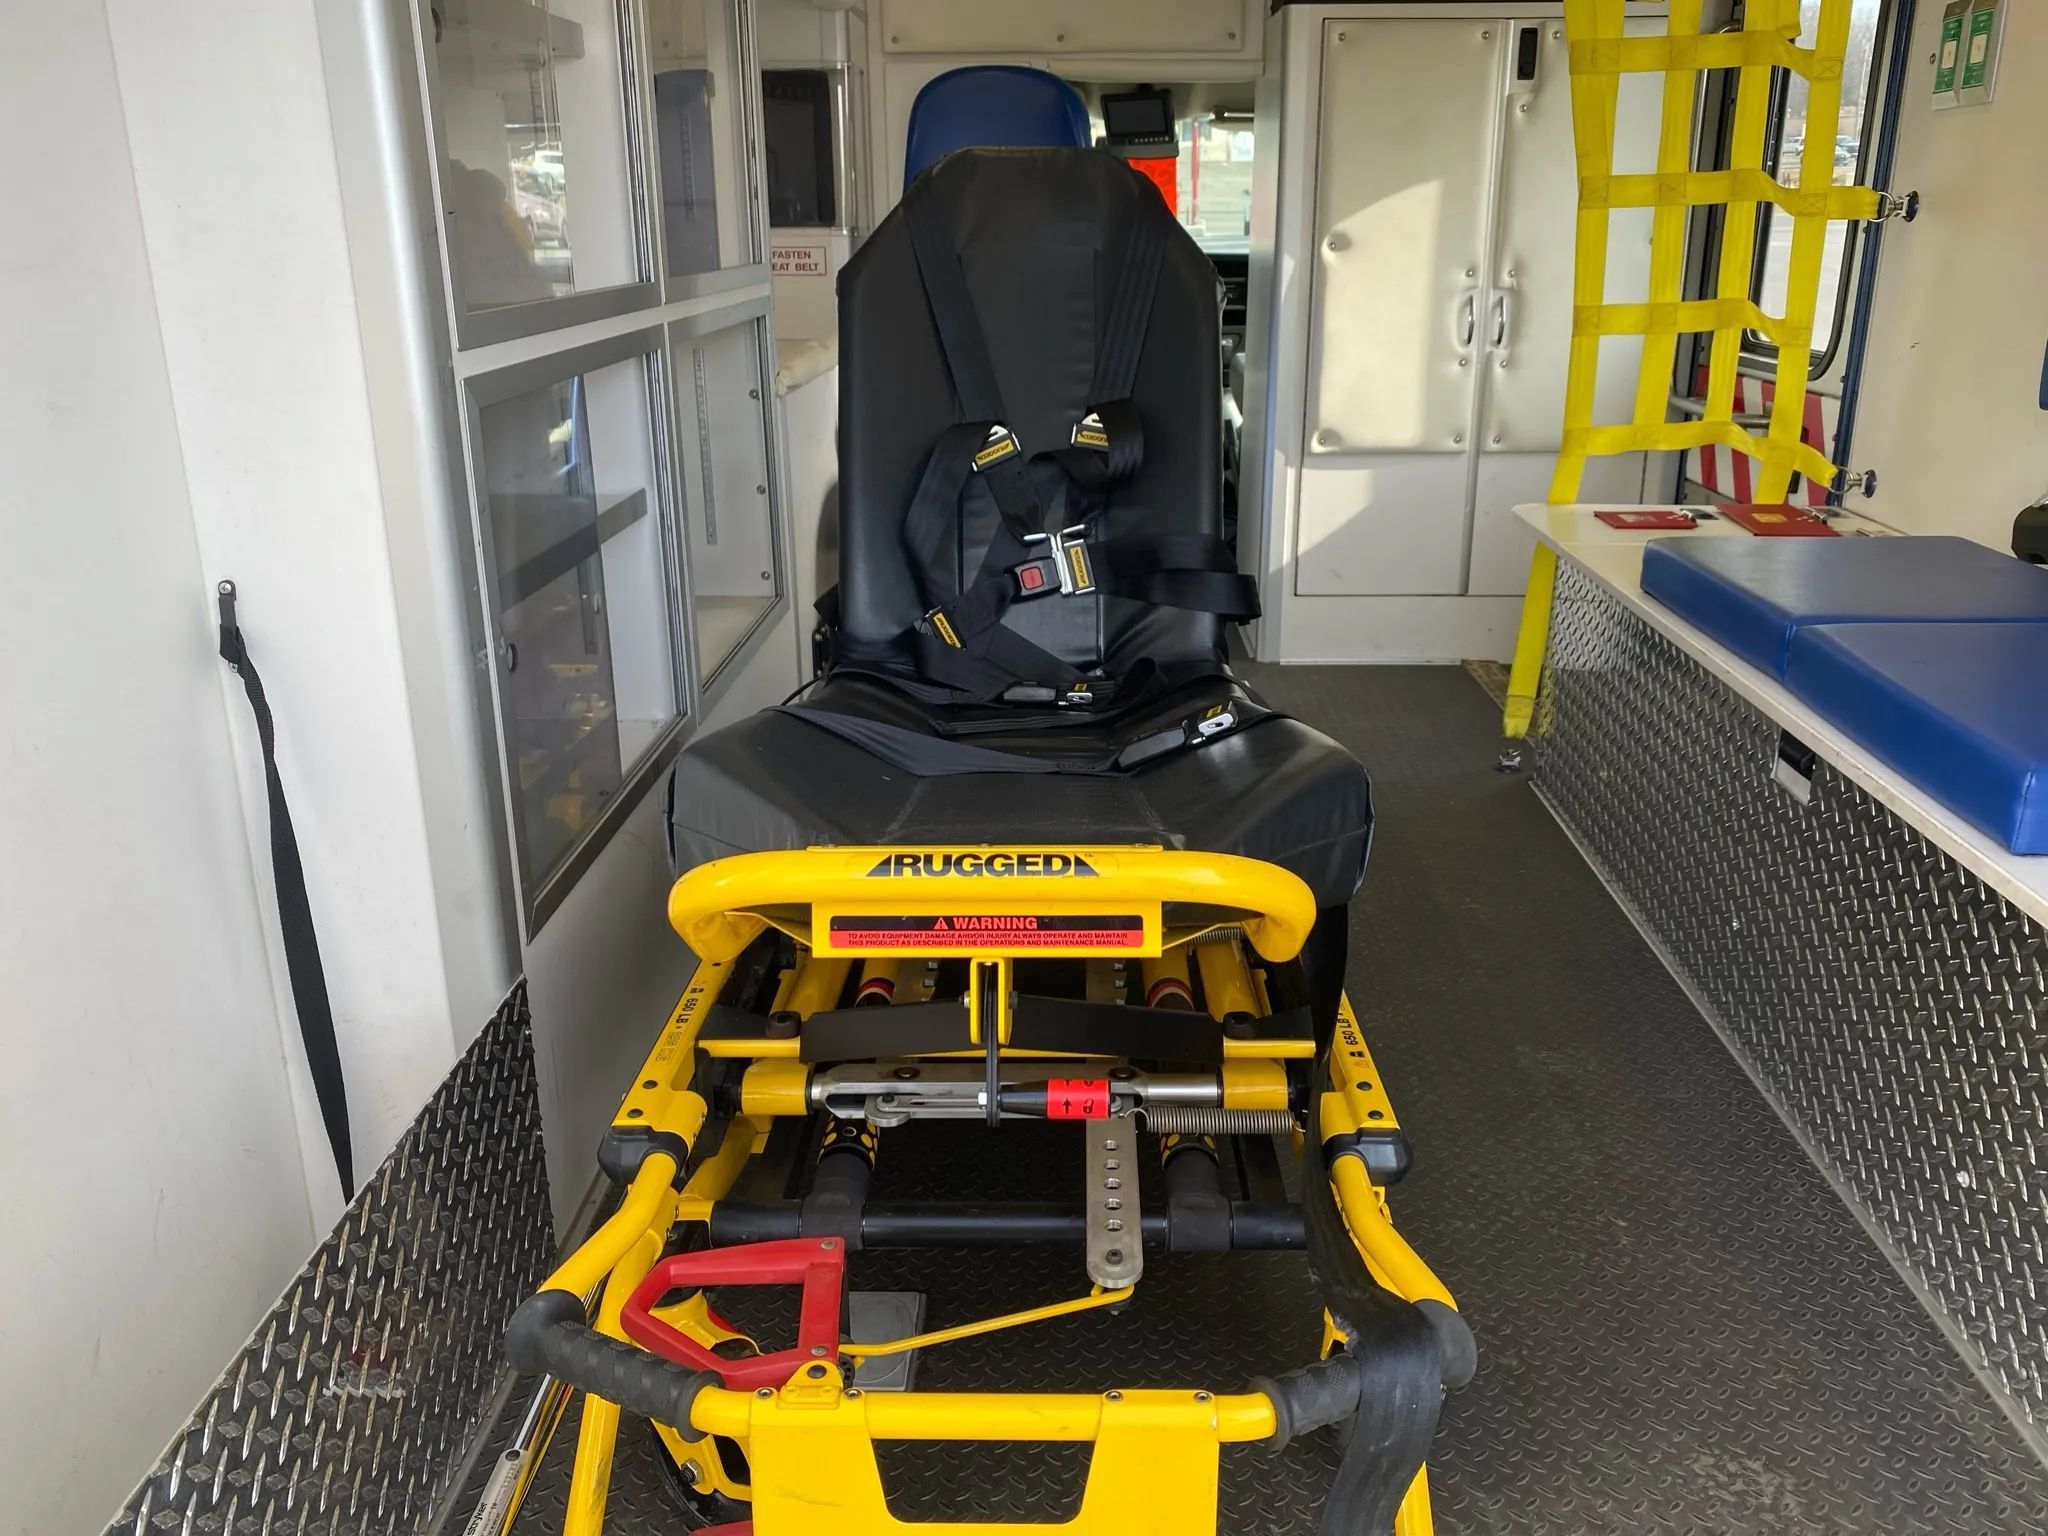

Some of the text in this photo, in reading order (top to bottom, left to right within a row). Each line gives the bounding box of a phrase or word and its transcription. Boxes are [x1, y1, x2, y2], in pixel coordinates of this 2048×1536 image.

[772, 250, 811, 259] FASTEN
[771, 262, 819, 271] EAT BELT
[893, 853, 1072, 877] RUGGED
[953, 916, 1038, 930] WARNING
[675, 998, 699, 1024] 650 LB
[1337, 1018, 1352, 1028] LB
[1342, 1030, 1359, 1045] 650
[467, 1502, 488, 1536] stryker
